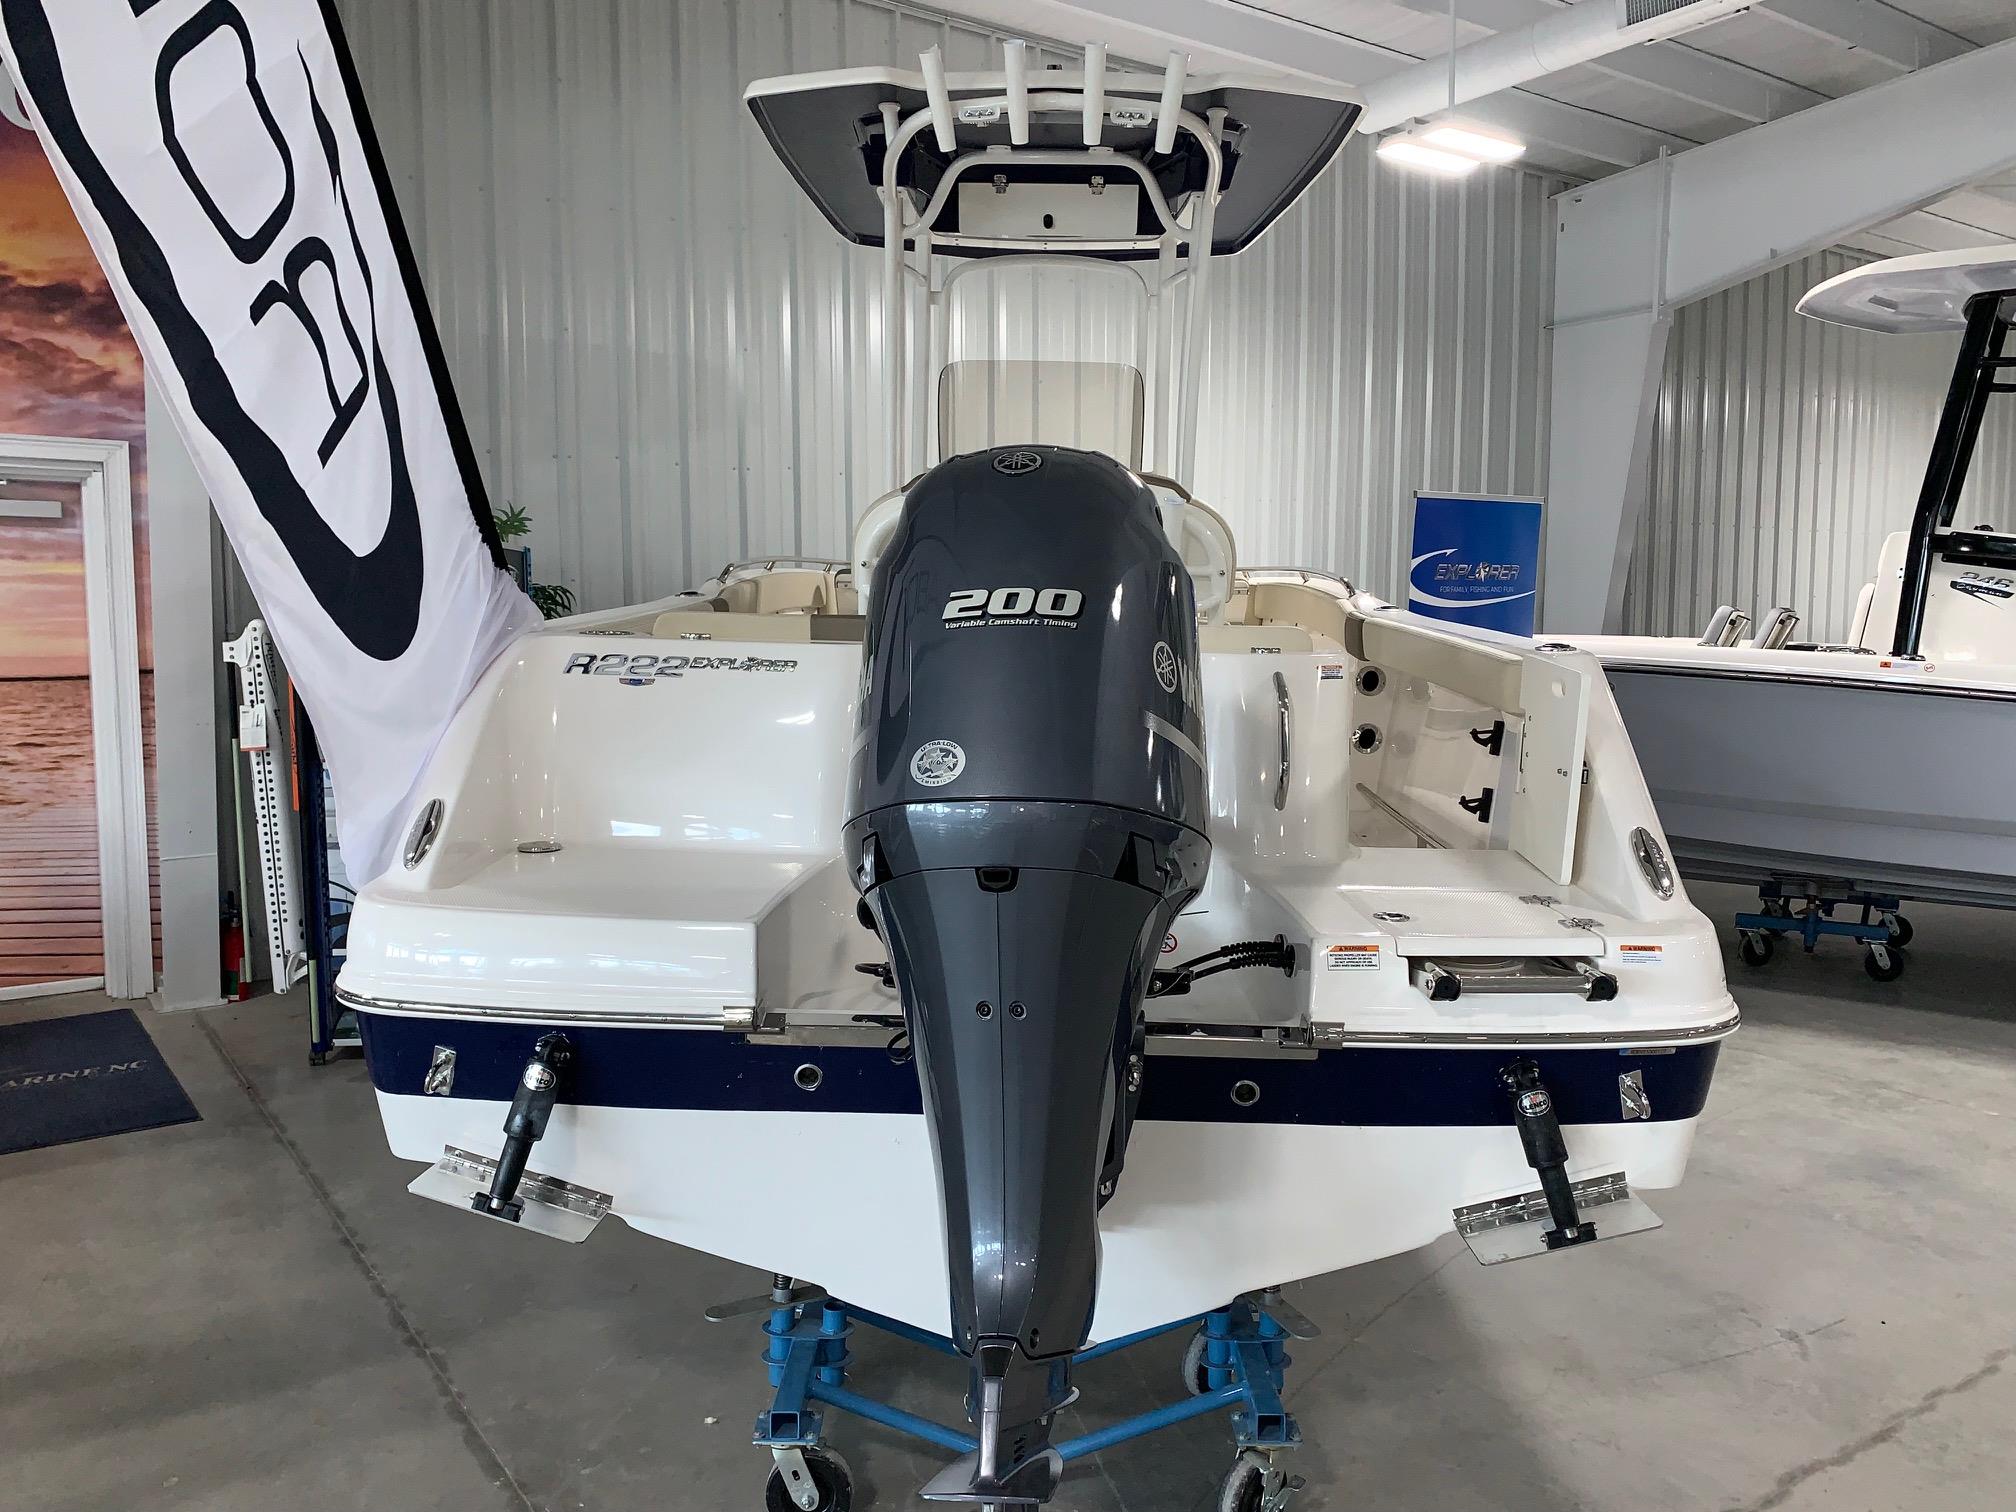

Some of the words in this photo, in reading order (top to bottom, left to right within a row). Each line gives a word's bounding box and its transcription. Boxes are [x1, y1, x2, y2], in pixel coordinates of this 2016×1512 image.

[1440, 585, 1449, 593] FOR
[942, 587, 1083, 619] 200
[945, 619, 985, 629] Variable
[988, 618, 1039, 626] Camshaft
[1043, 618, 1078, 629] Timing
[562, 652, 689, 678] R222
[109, 1059, 148, 1073] NC
[1525, 1100, 1547, 1110] LENCO
